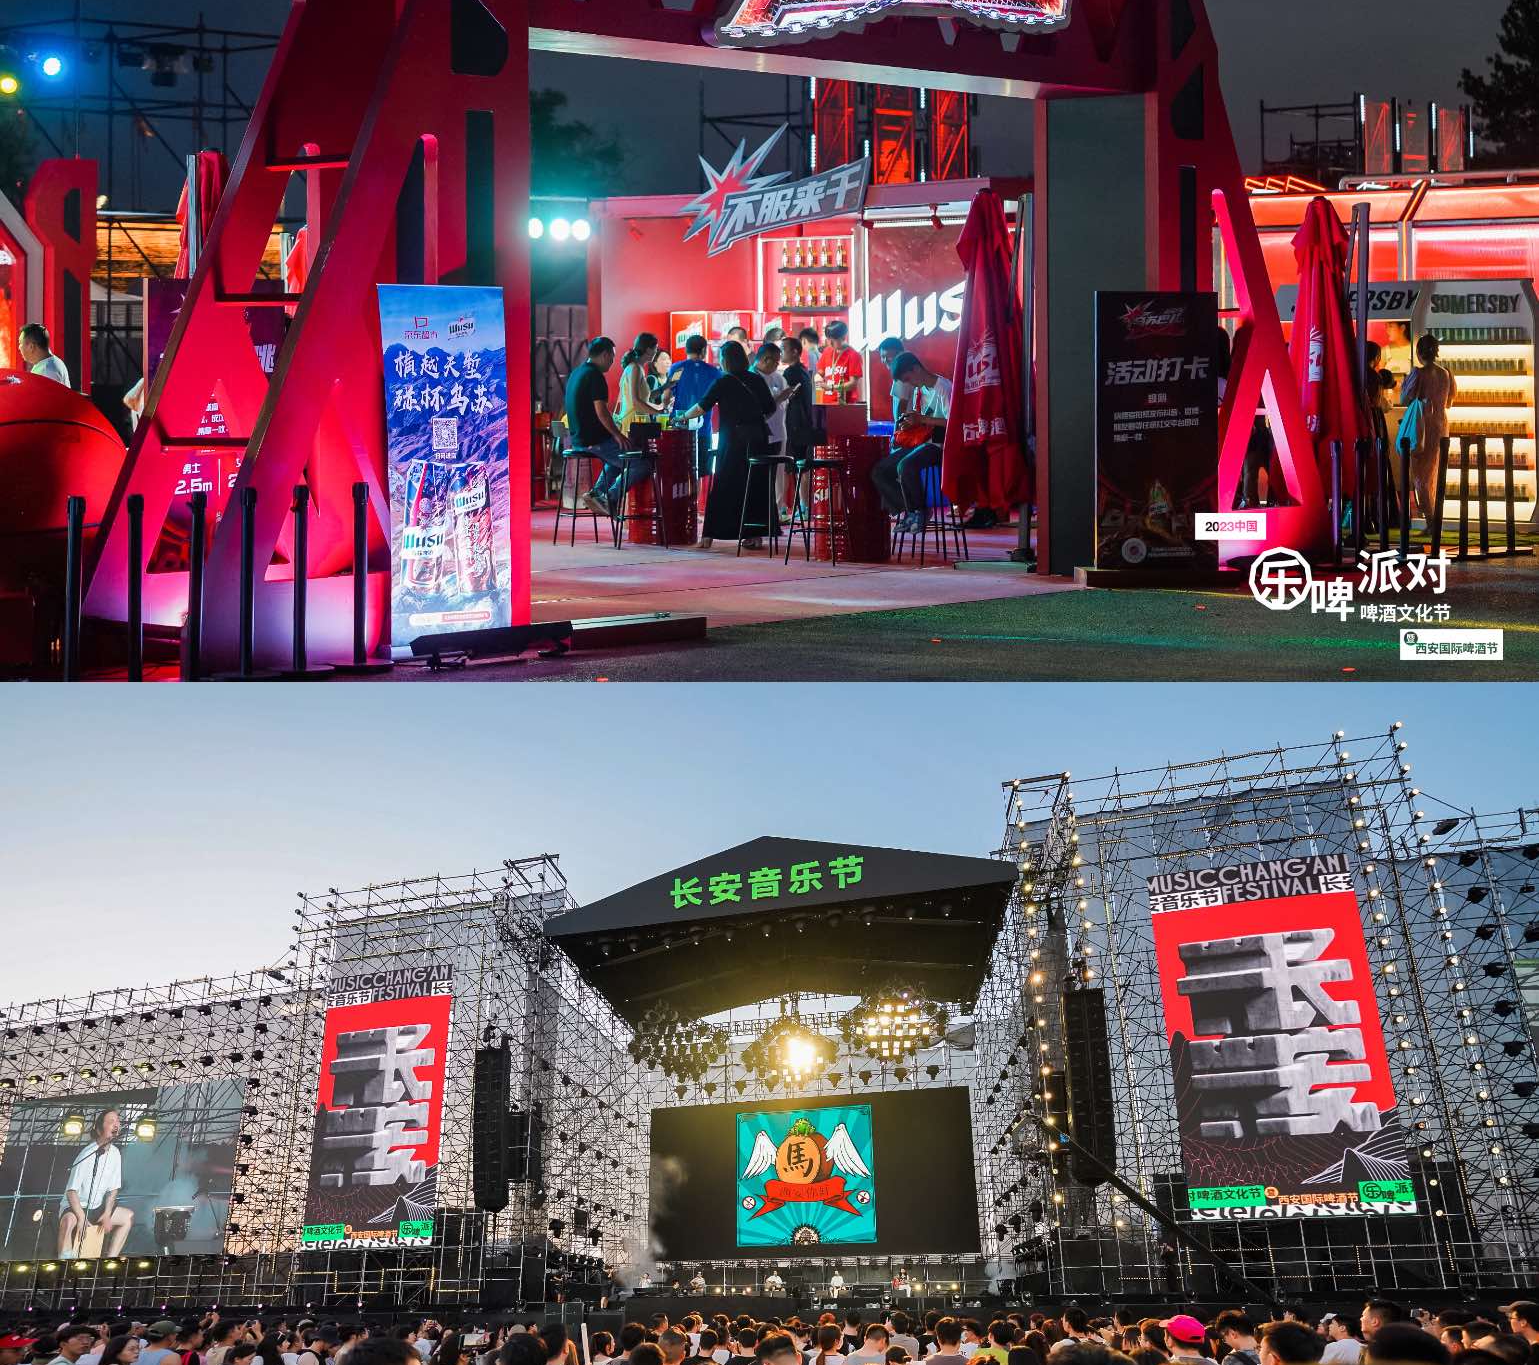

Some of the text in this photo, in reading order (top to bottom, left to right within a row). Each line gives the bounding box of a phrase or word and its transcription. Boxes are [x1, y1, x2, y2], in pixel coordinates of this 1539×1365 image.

[718, 164, 862, 243] 不服来干
[1430, 293, 1520, 315] SOMERSBY
[1105, 356, 1210, 386] 活动打卡
[182, 464, 201, 474] 男士
[174, 479, 213, 495] 2.5m
[670, 855, 865, 910] 长安音乐节
[1150, 869, 1218, 895] MUSIC
[1222, 875, 1319, 904] FESTIVAL
[371, 982, 430, 1002] FESTIVAL
[784, 1141, 813, 1178] 馬
[1279, 1192, 1358, 1205] 西安国际啤酒节
